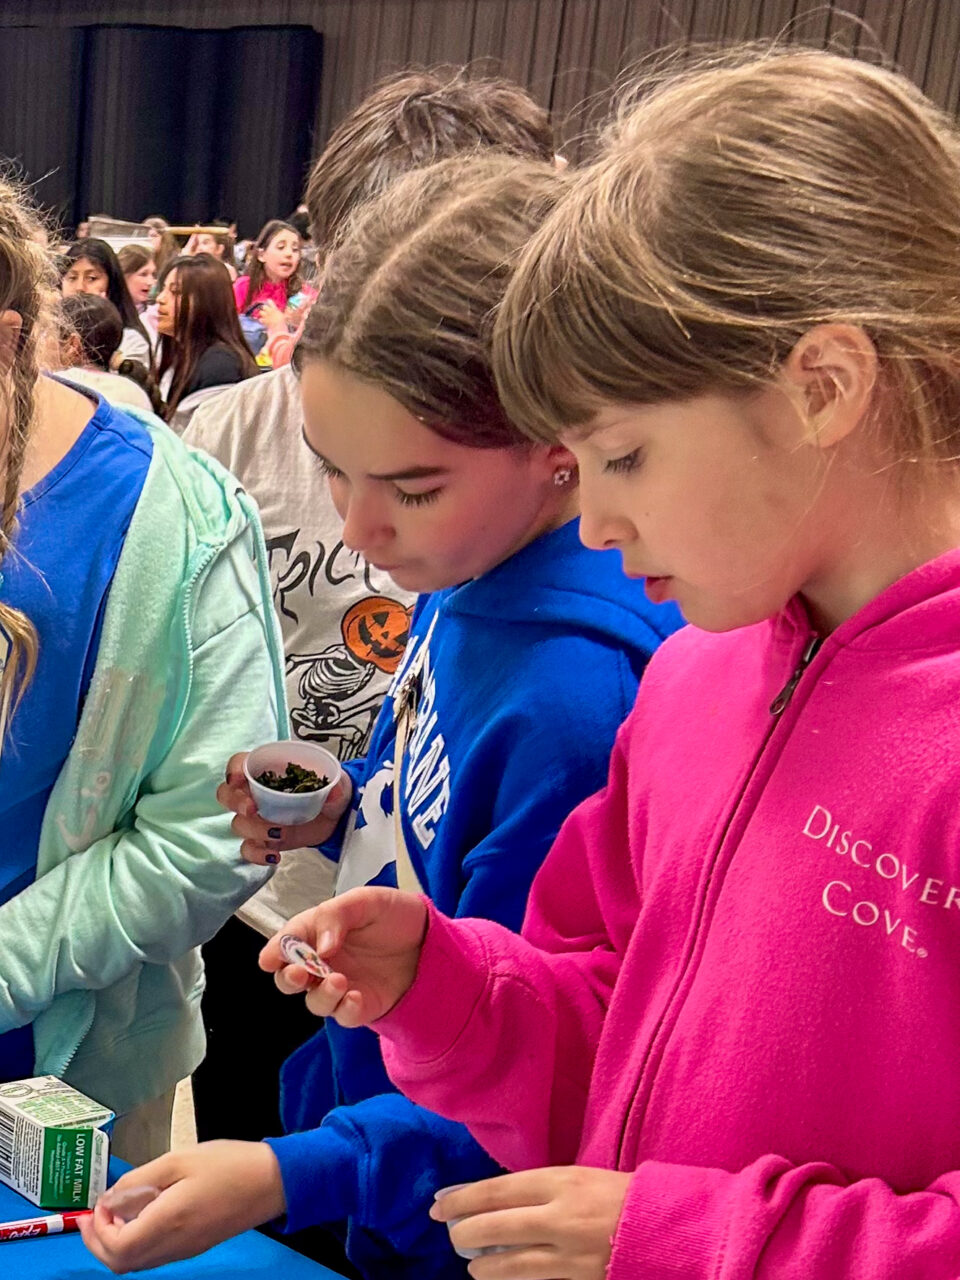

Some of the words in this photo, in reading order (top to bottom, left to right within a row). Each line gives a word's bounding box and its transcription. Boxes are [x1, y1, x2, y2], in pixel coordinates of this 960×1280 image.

[802, 804, 960, 911] DISCOVER
[75, 1133, 86, 1156] LOW
[74, 1158, 85, 1176] FAT
[72, 1178, 83, 1203] MILK
